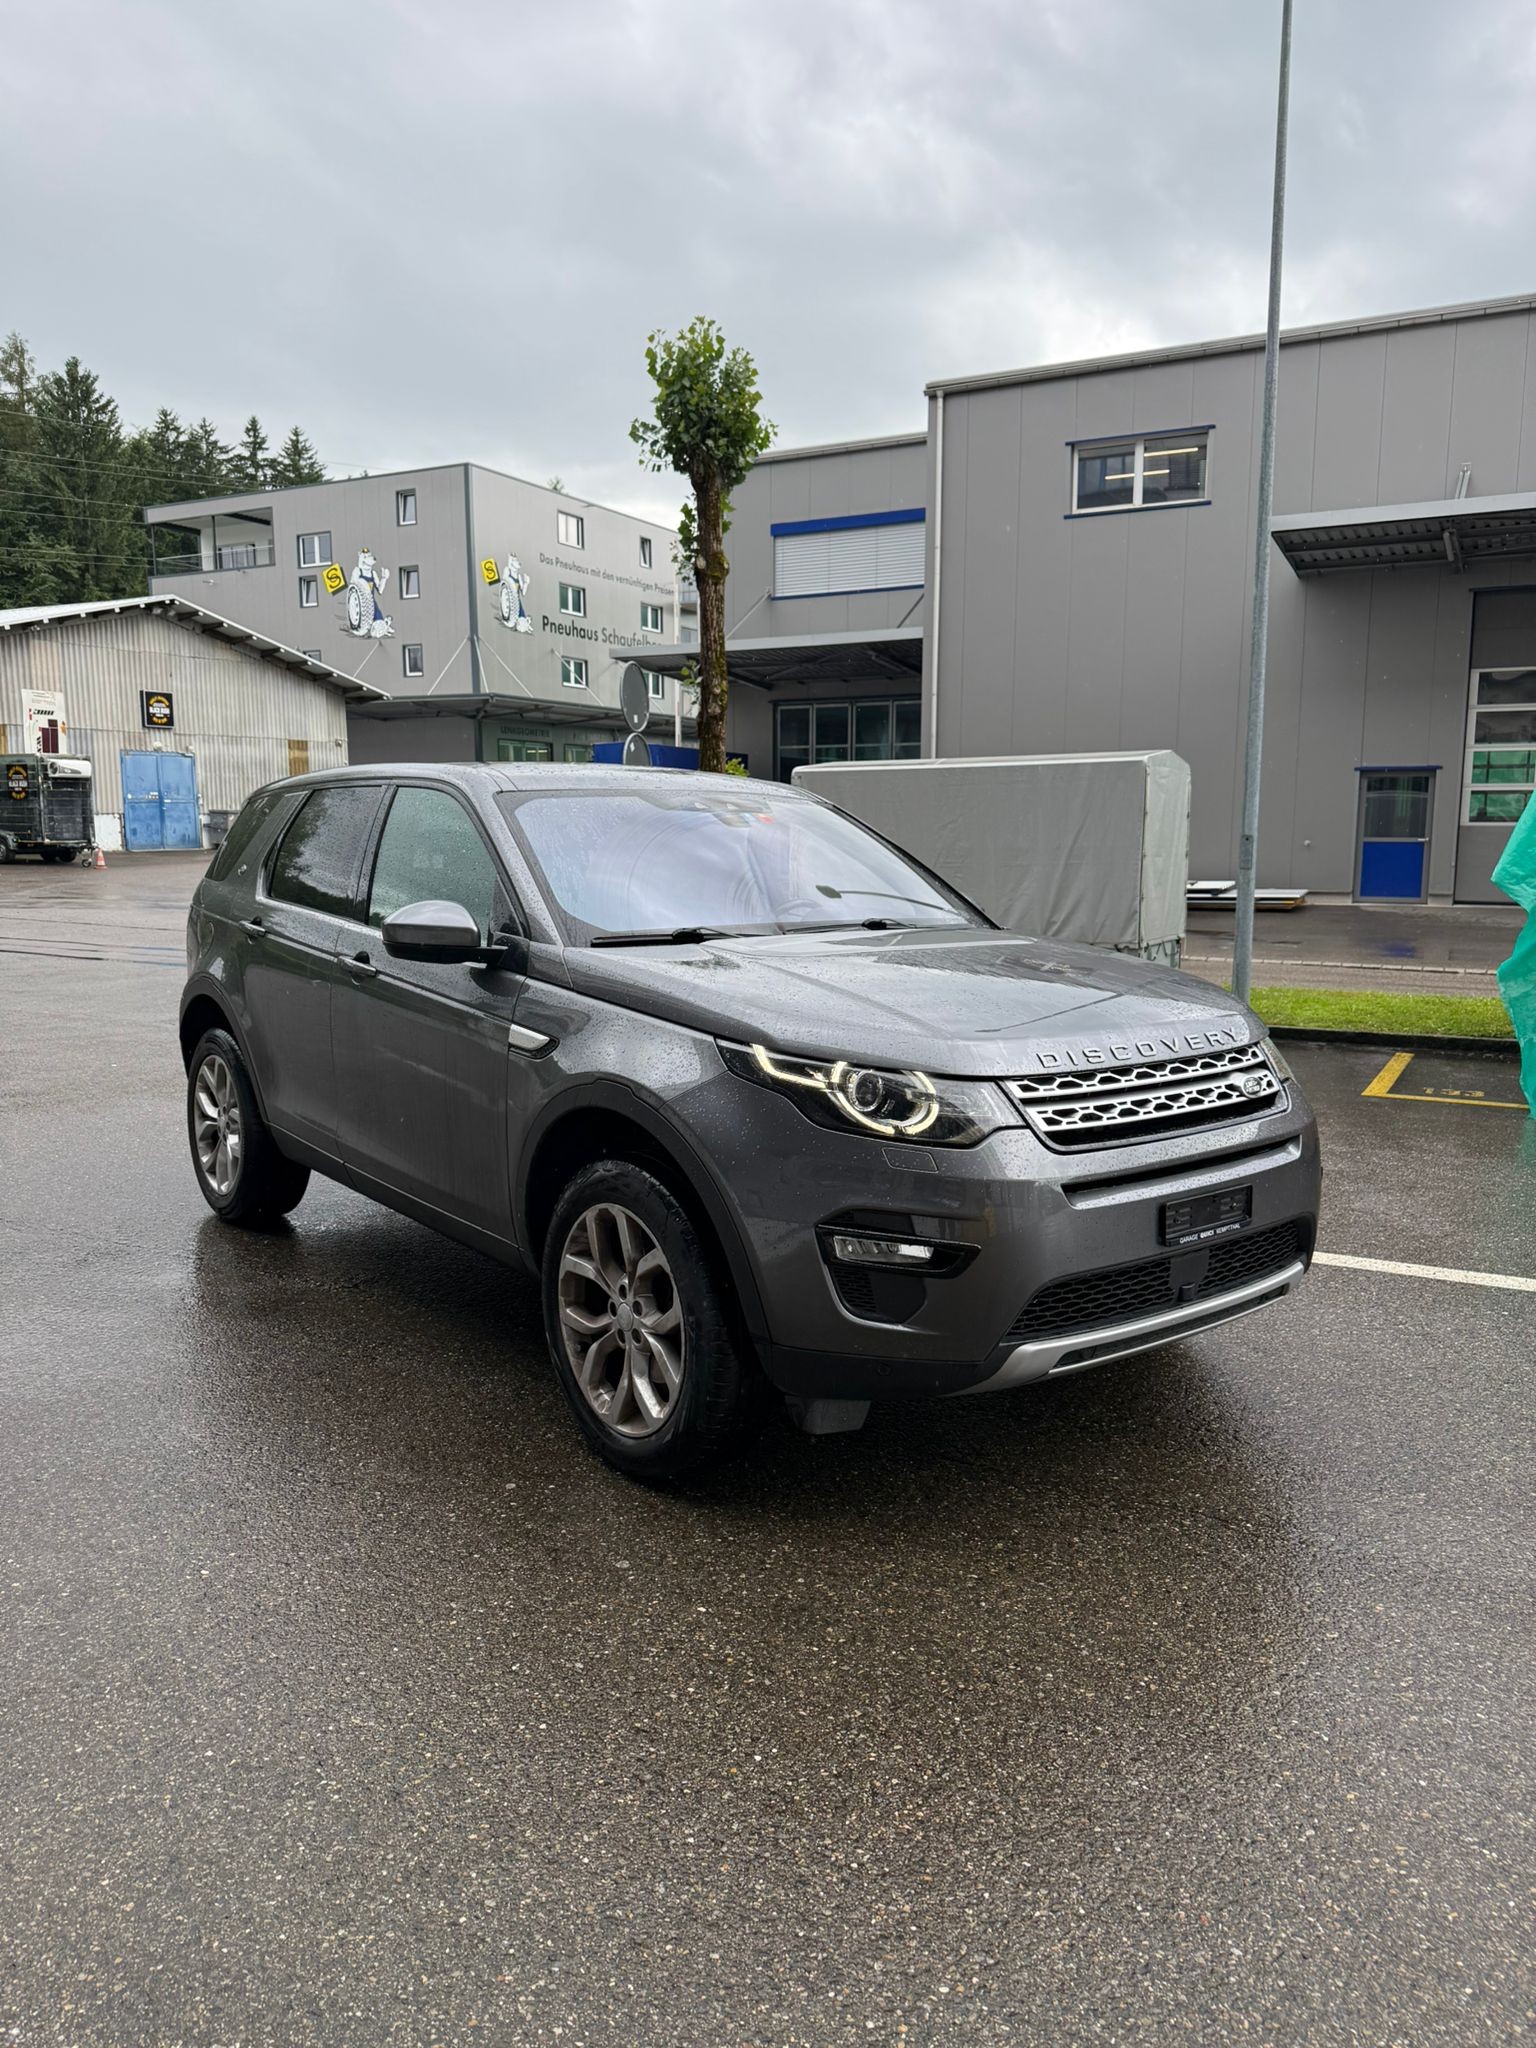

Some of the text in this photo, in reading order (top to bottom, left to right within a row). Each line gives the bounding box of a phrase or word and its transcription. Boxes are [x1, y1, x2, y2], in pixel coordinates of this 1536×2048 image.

[539, 552, 554, 566] Das
[555, 556, 589, 575] Pneuhaus
[590, 567, 601, 578] mit
[602, 569, 615, 583] den
[616, 576, 653, 593] vernünftigen
[542, 615, 598, 641] Pneuhaus
[1036, 1027, 1238, 1069] DISCOVERY
